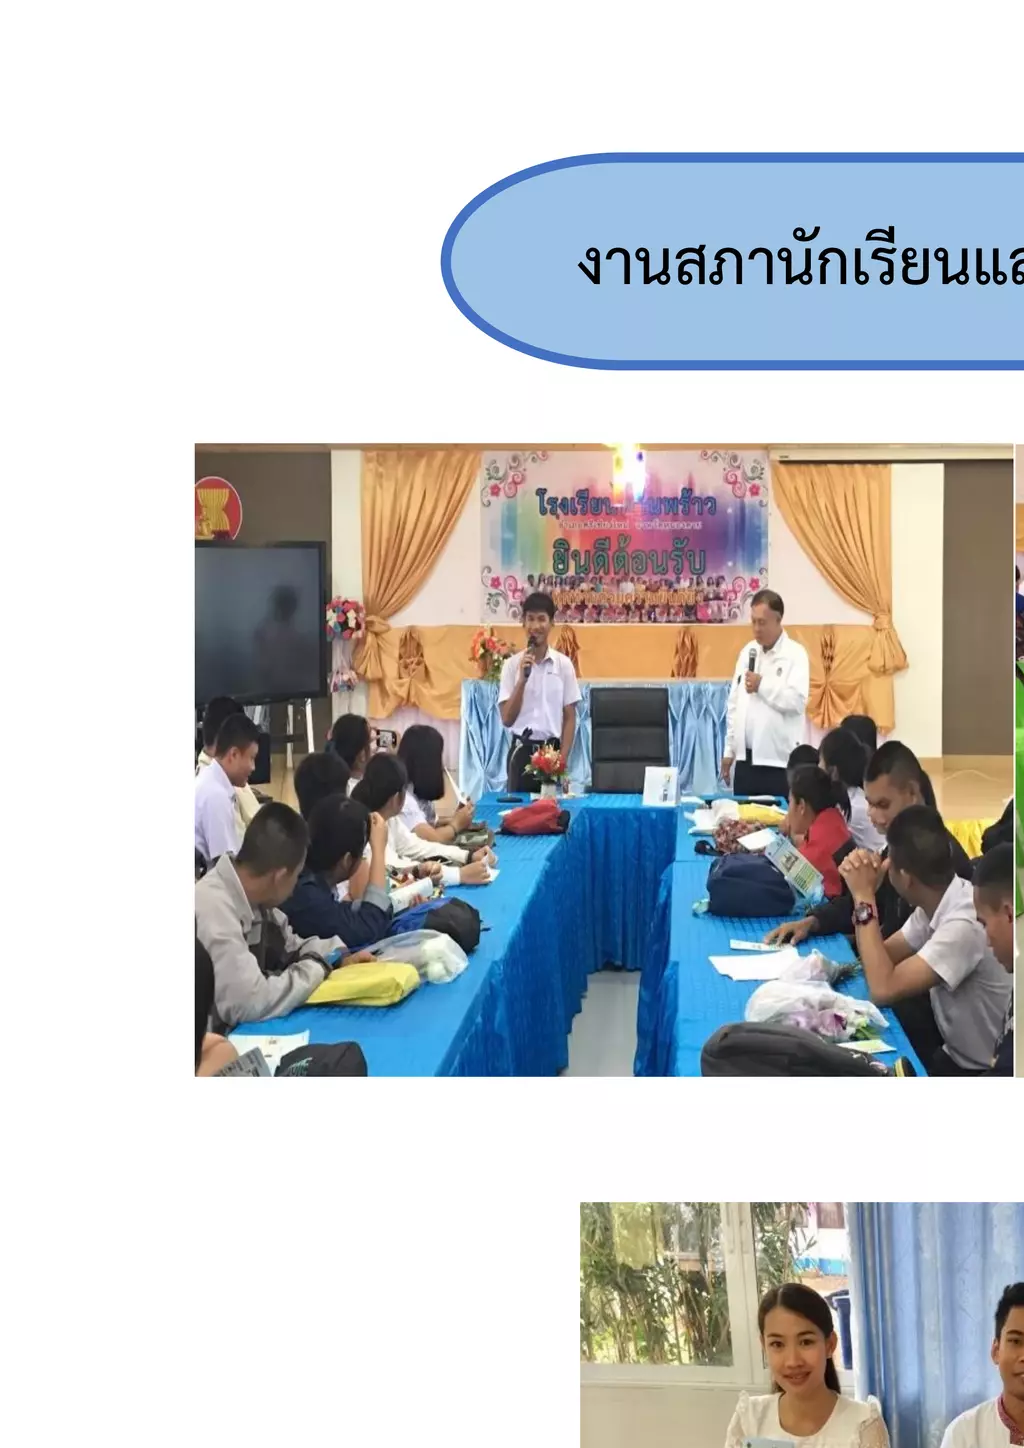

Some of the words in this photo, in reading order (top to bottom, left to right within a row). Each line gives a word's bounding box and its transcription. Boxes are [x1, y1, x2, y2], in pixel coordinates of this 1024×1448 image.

[535, 488, 717, 518] โรงเรียนนพร้าว
[552, 533, 706, 576] ยินดีต้อนรับ
